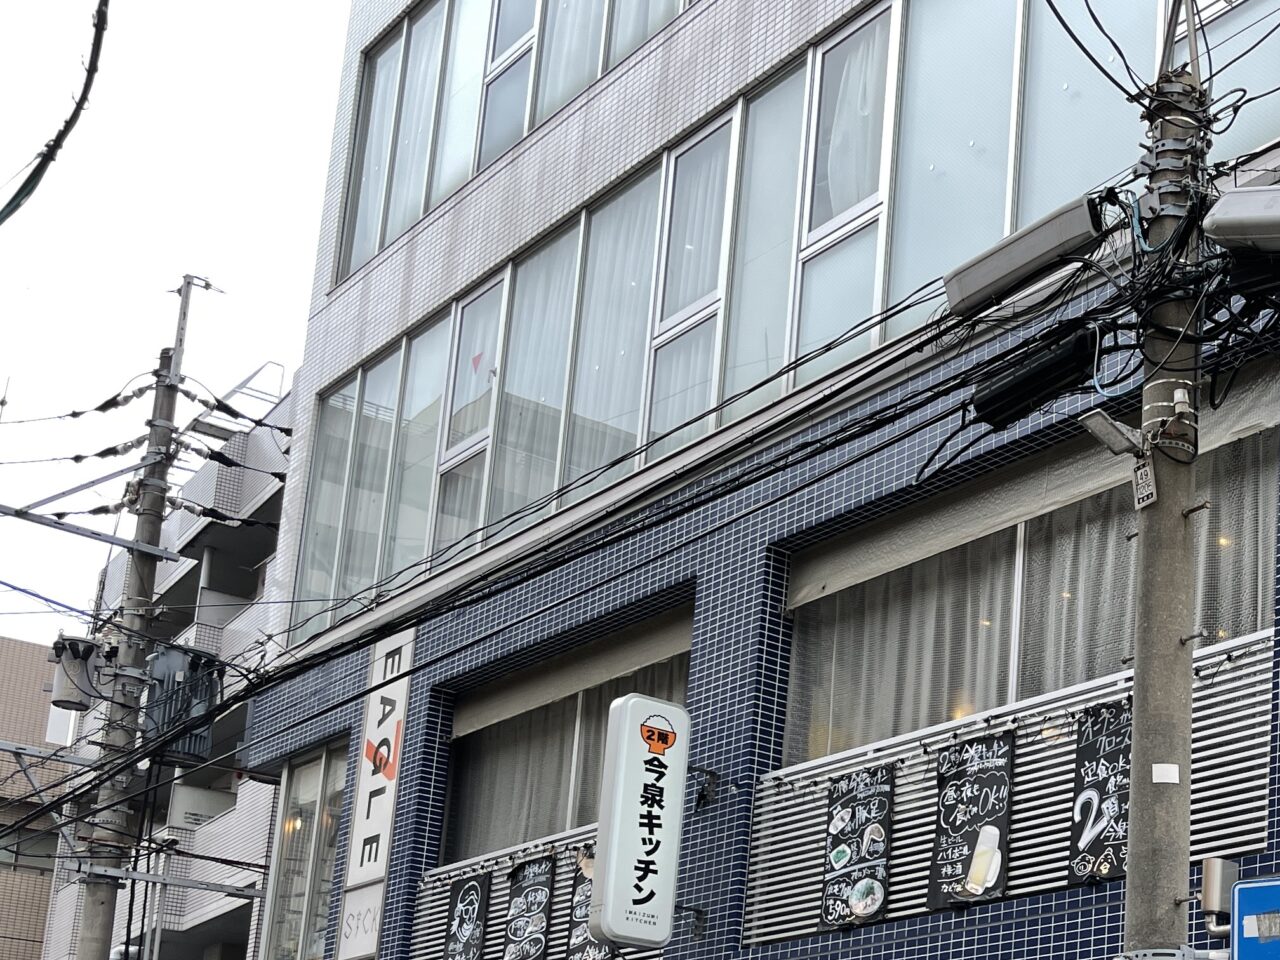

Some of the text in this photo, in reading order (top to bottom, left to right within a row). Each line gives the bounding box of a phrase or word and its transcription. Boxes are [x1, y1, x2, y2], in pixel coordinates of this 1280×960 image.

[645, 729, 670, 746] 2階
[360, 649, 399, 868] EAGLE
[632, 756, 669, 906] 今泉キッチン
[625, 909, 659, 920] IMAIZUMI
[625, 916, 658, 926] KITCHEN
